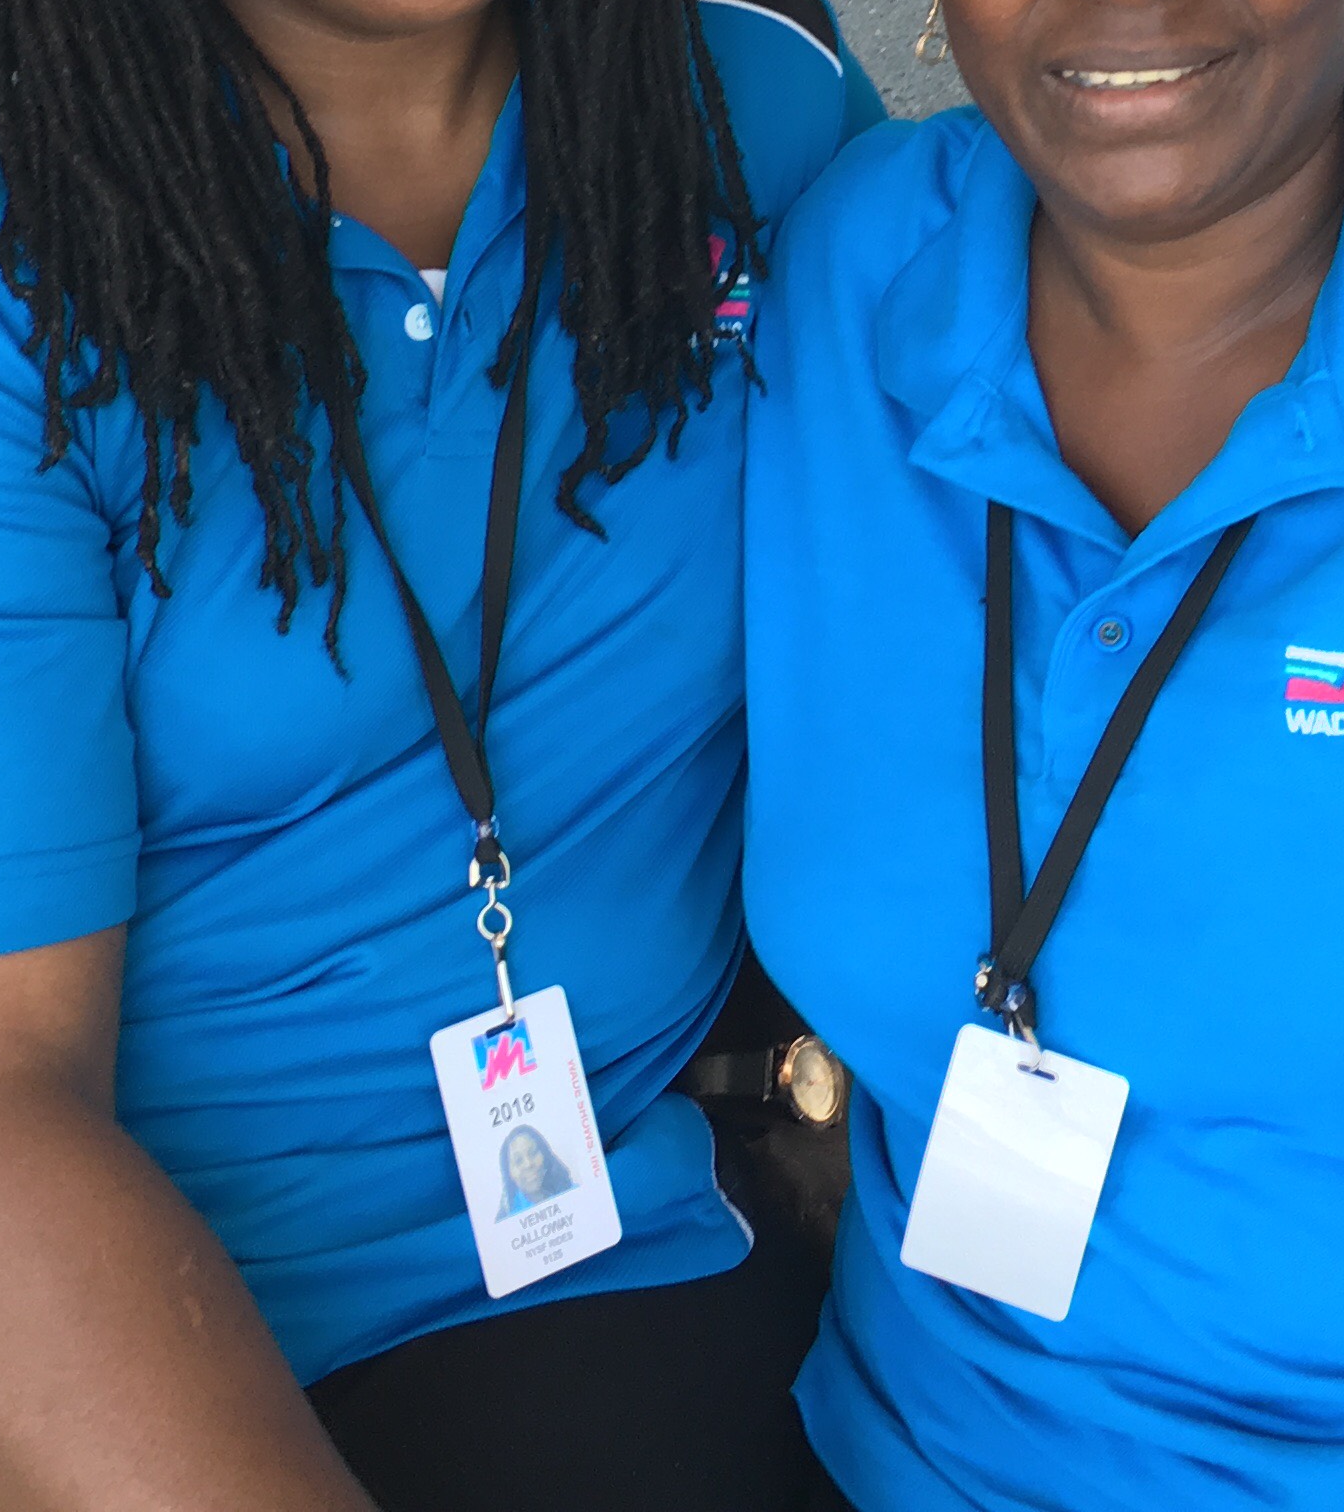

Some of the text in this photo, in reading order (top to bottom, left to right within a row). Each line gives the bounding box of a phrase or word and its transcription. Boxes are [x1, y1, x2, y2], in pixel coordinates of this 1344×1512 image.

[489, 1093, 535, 1128] 2018
[511, 1213, 574, 1250] CALLOWAY
[519, 1203, 561, 1230] VENITA
